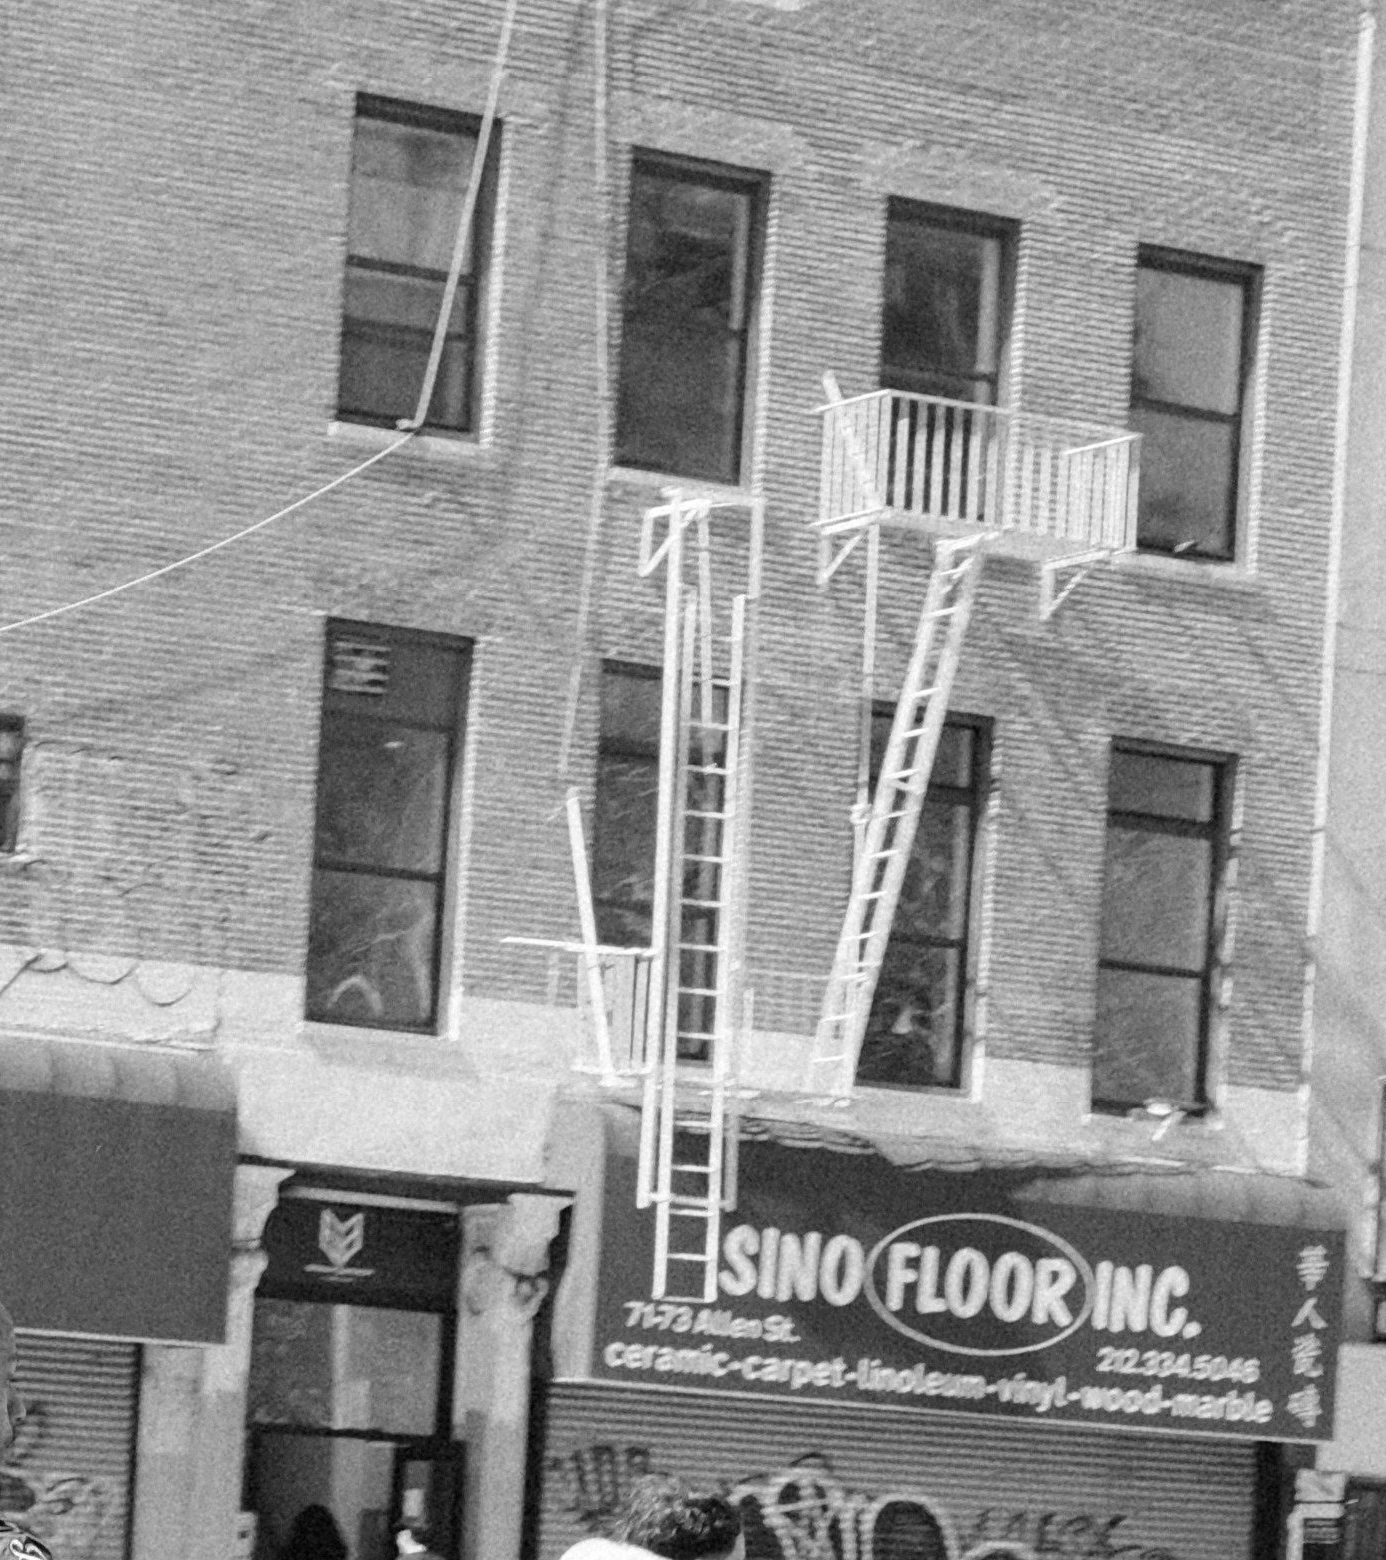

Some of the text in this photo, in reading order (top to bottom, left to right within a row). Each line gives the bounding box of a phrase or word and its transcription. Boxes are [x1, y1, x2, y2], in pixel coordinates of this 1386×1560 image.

[718, 1223, 1203, 1339] SINO FLOOR INC.
[692, 1308, 763, 1339] Allen
